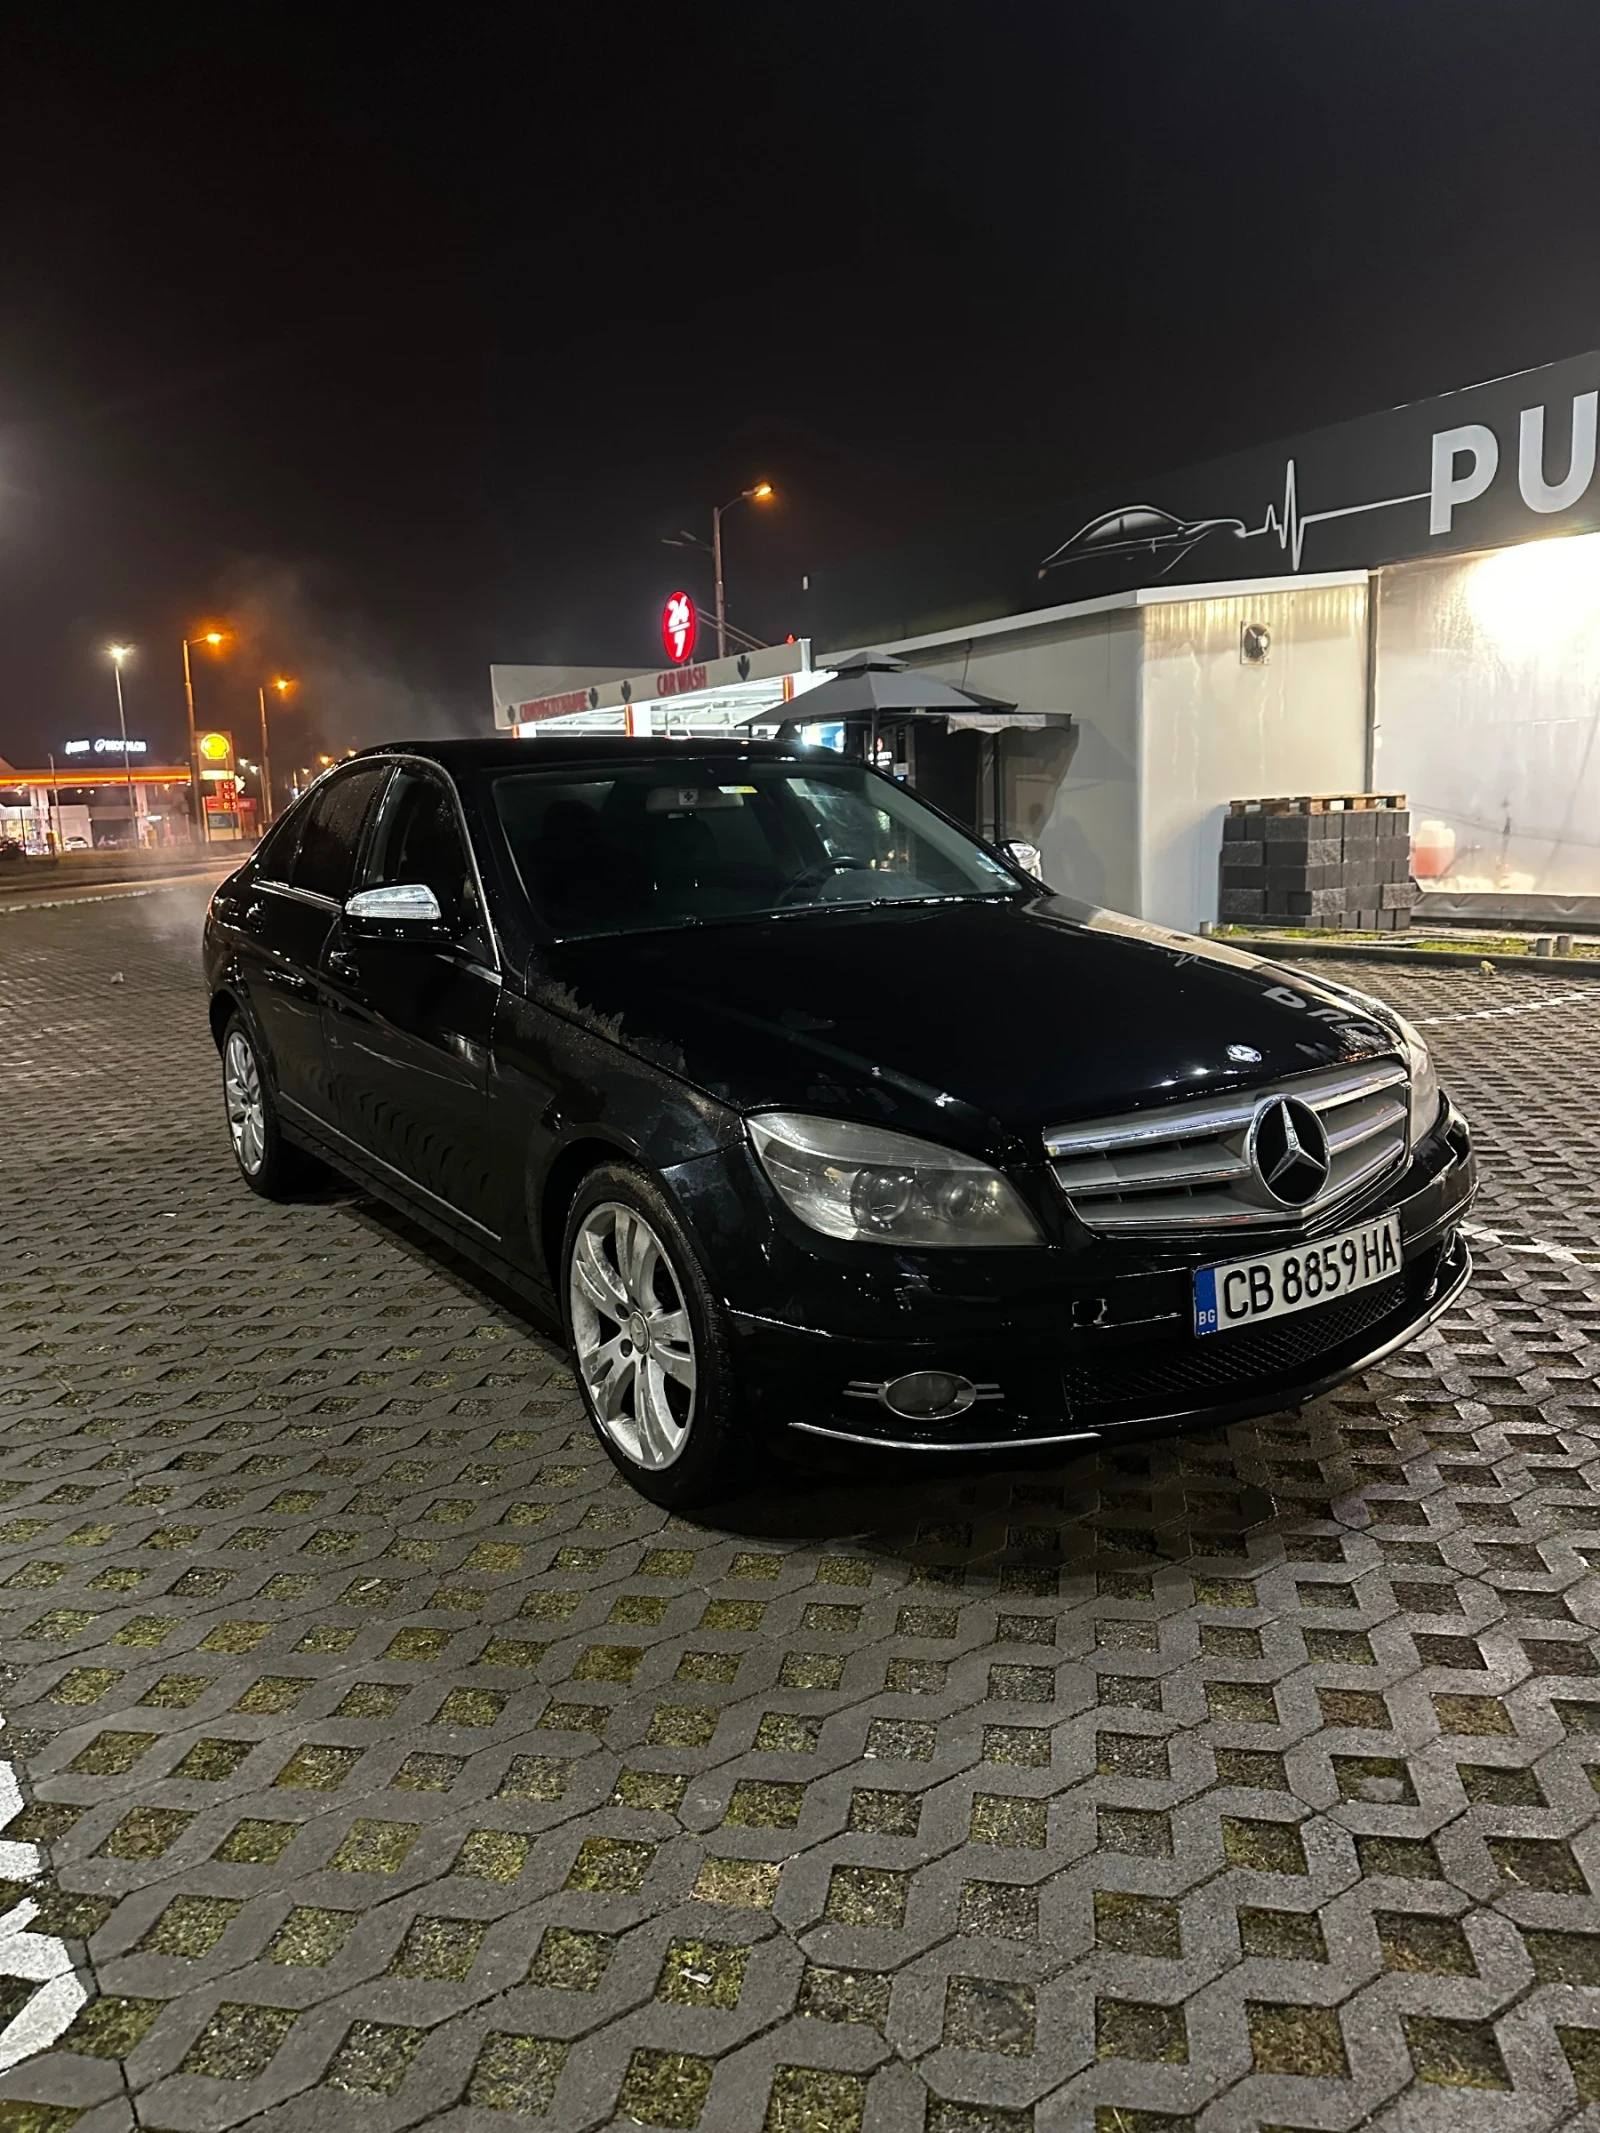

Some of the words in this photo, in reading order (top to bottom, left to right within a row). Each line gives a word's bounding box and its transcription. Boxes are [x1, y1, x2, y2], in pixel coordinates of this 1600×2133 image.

[1430, 391, 1599, 535] PU
[668, 595, 689, 627] 24
[674, 630, 686, 657] 7
[657, 672, 676, 697] CAR
[676, 665, 706, 693] WASH
[1224, 1264, 1273, 1319] CB
[1282, 1237, 1357, 1304] 8859
[1362, 1221, 1397, 1278] HA
[1199, 1309, 1215, 1325] BG
